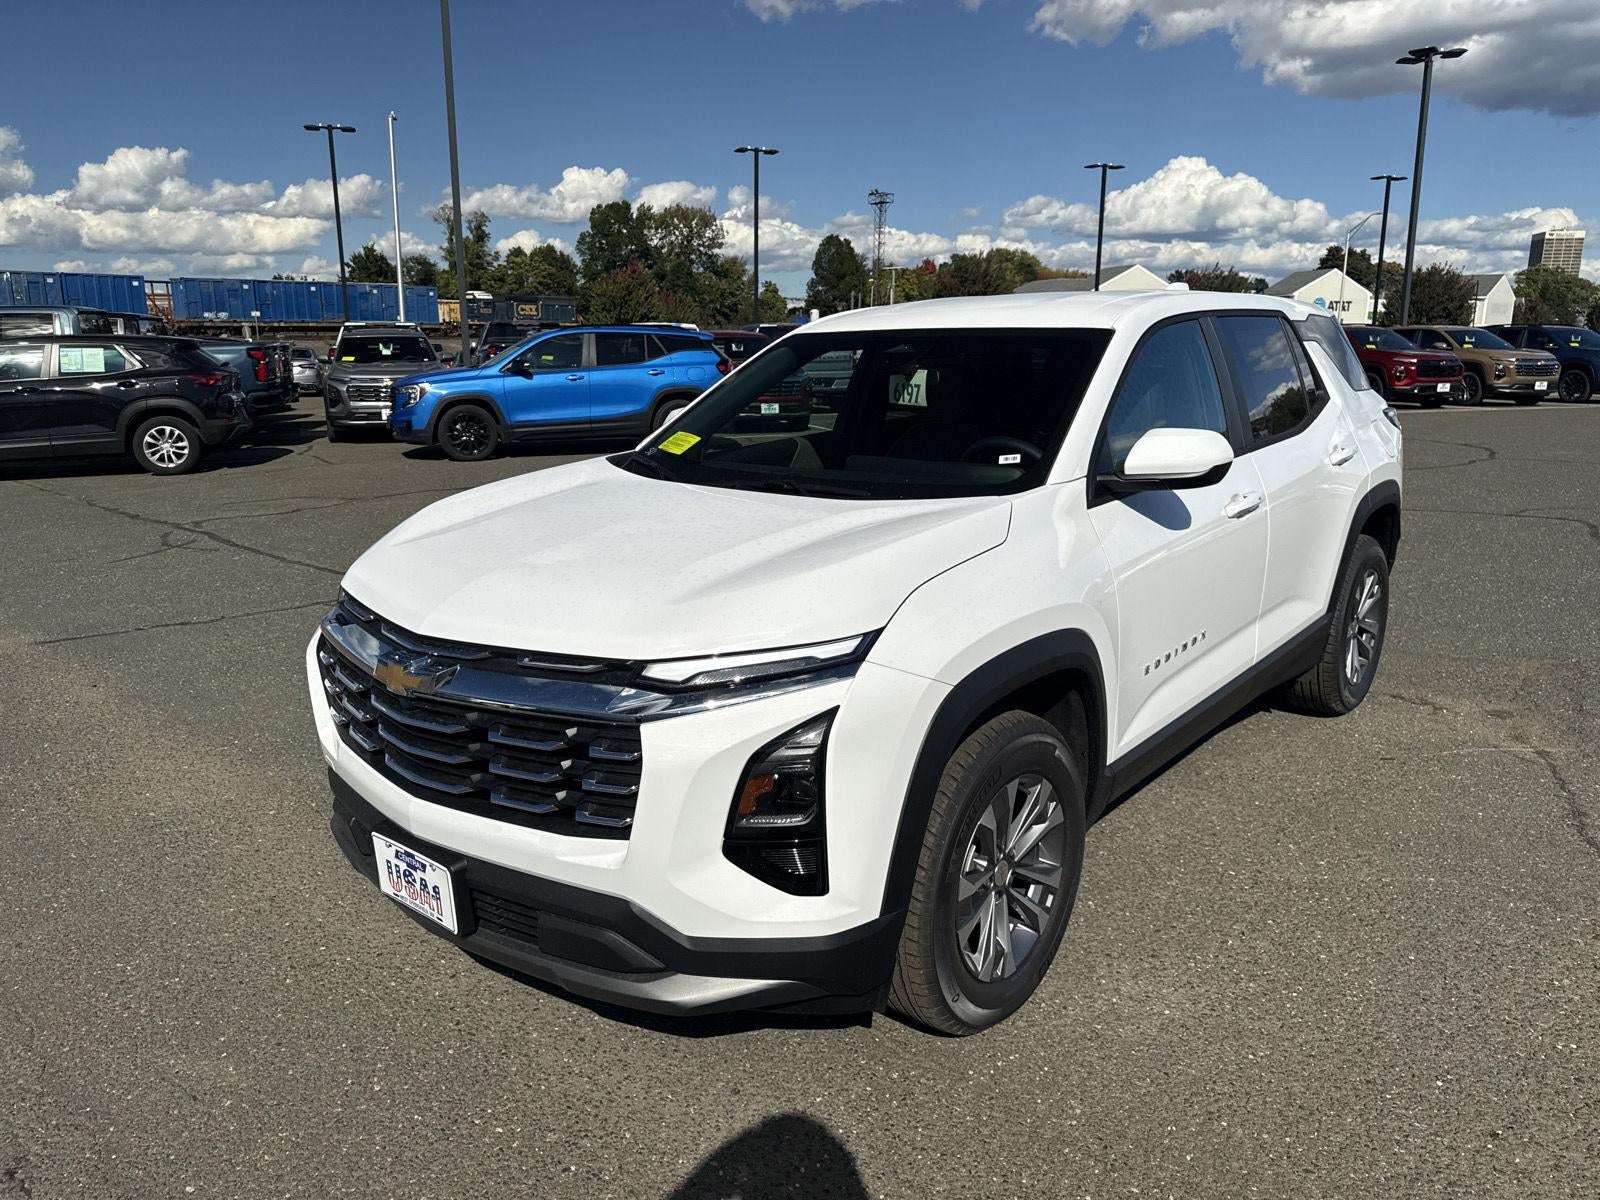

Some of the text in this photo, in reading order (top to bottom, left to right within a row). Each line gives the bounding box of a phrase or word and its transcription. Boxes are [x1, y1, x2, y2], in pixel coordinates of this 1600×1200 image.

[517, 304, 538, 316] CSX
[1327, 300, 1352, 312] AT&T
[894, 383, 921, 403] 6197
[1143, 630, 1207, 676] EQUINOX
[397, 851, 425, 872] CENTRAL
